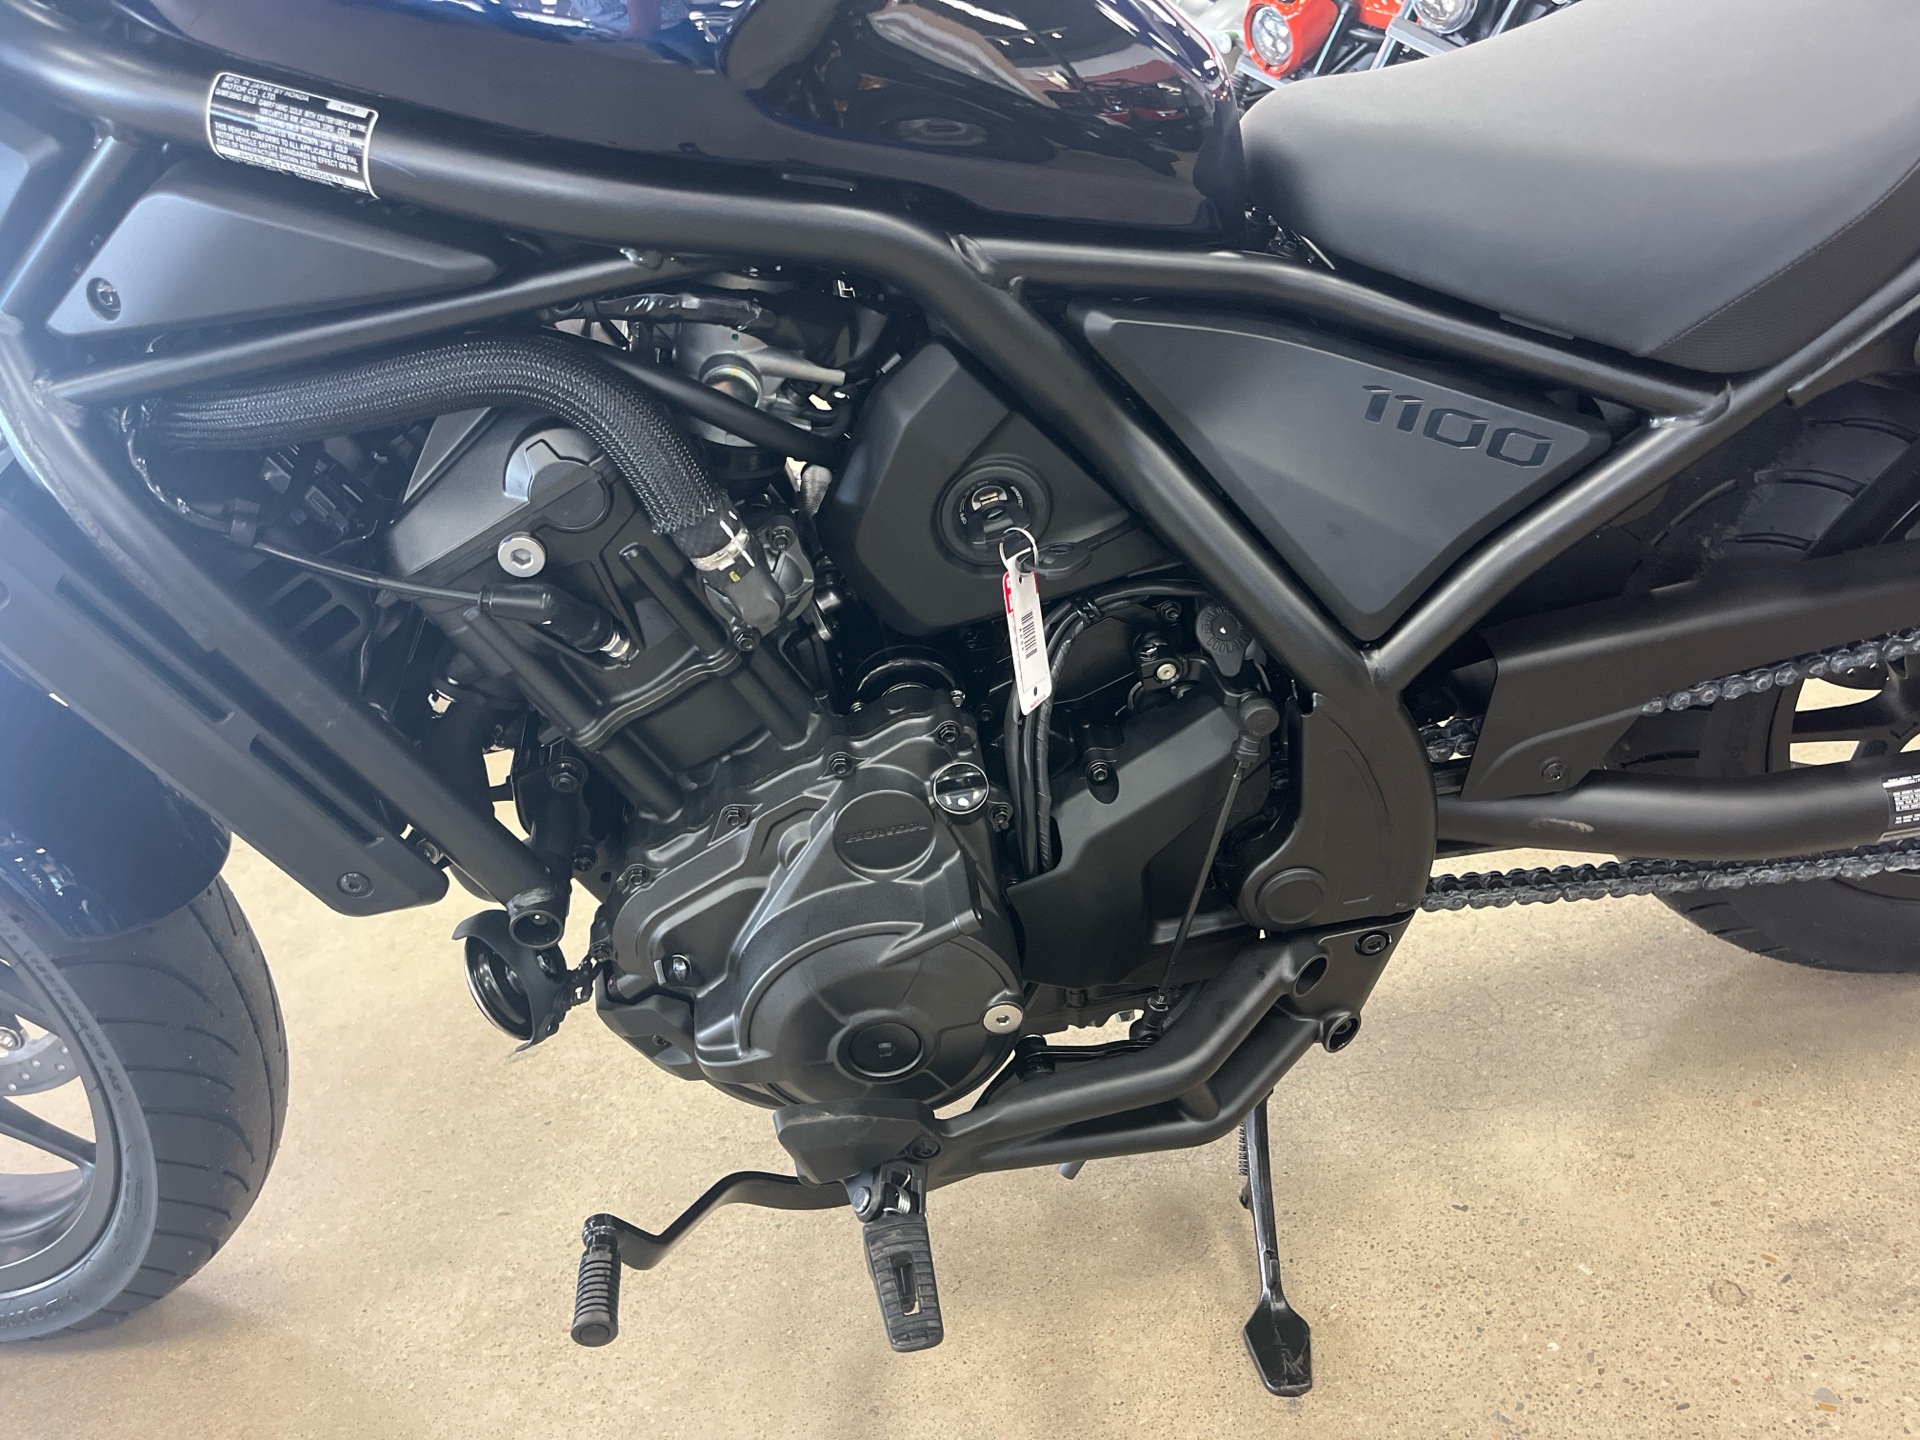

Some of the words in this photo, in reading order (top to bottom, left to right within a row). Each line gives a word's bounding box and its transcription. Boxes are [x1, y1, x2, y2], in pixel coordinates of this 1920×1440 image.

[221, 80, 246, 93] MOTOR
[262, 90, 276, 101] LTD.
[250, 81, 272, 92] JAPAN
[274, 87, 282, 95] BY
[284, 90, 309, 102] HONDA
[215, 121, 226, 131] THIS
[228, 124, 249, 137] VEHICLE
[250, 129, 279, 145] CONFORMS
[300, 143, 331, 158] APPLICABLE
[333, 152, 357, 165] FEDERAL
[215, 129, 234, 140] MOTOR
[235, 134, 256, 146] VEHICLE
[258, 140, 277, 152] SAFETY
[279, 146, 310, 160] STANDARDS
[317, 155, 337, 168] EFFECT
[348, 163, 358, 173] THE
[216, 137, 230, 147] DATE
[239, 142, 278, 159] MANUFACTURE
[279, 153, 298, 164] SHOWN
[1363, 385, 1555, 469] 1100
[843, 823, 928, 844] HONDA
